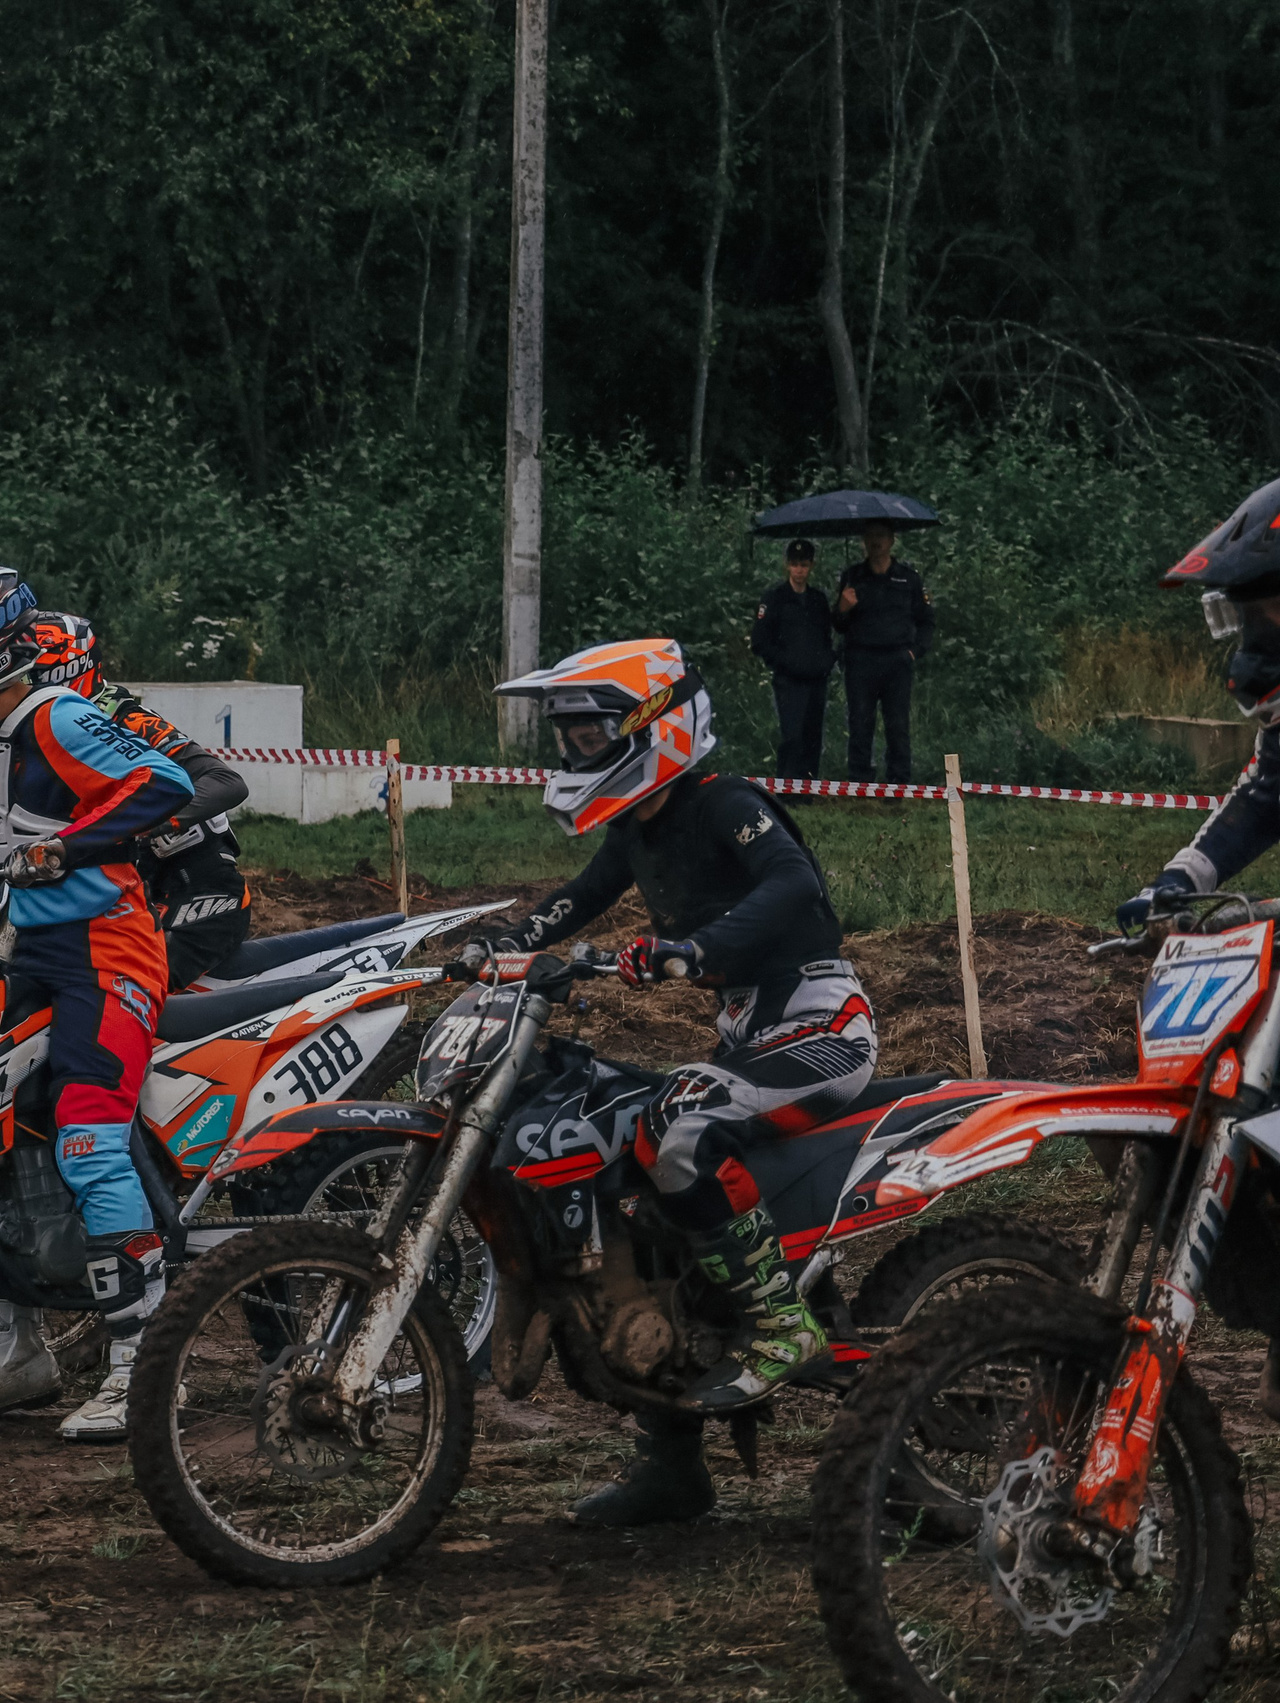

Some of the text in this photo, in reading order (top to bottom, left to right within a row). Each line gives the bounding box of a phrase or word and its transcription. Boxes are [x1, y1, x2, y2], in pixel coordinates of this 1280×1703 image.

[215, 704, 232, 748] 1
[621, 687, 671, 736] FMF
[73, 714, 144, 762] DELICATE
[238, 1021, 267, 1038] ATHENA
[273, 1023, 363, 1104] 388
[63, 1133, 97, 1145] DELICATE
[185, 1098, 224, 1141] MOTOREX
[63, 1141, 96, 1160] FOX
